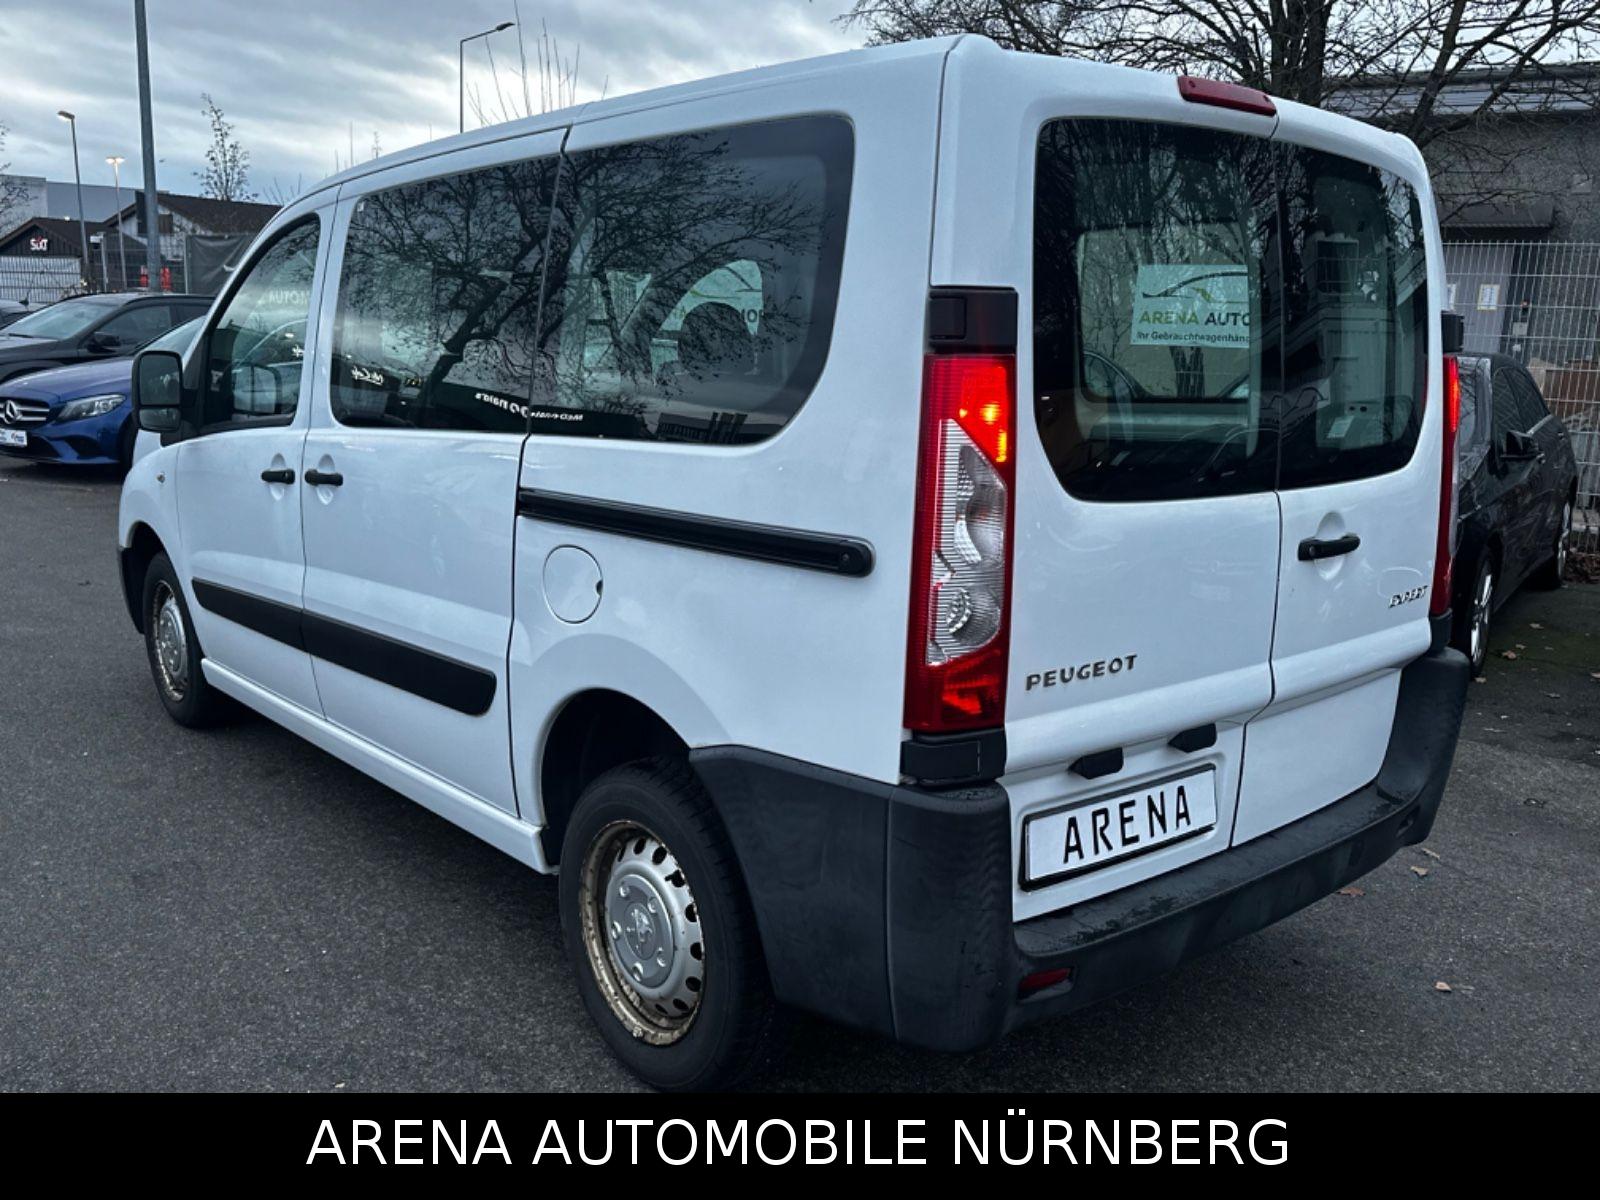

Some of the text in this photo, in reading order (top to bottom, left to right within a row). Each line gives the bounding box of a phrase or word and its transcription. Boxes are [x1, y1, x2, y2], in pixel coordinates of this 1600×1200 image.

[1138, 310, 1199, 325] ARENA
[1025, 654, 1138, 691] PEUGEOT
[1063, 785, 1192, 864] ARENA
